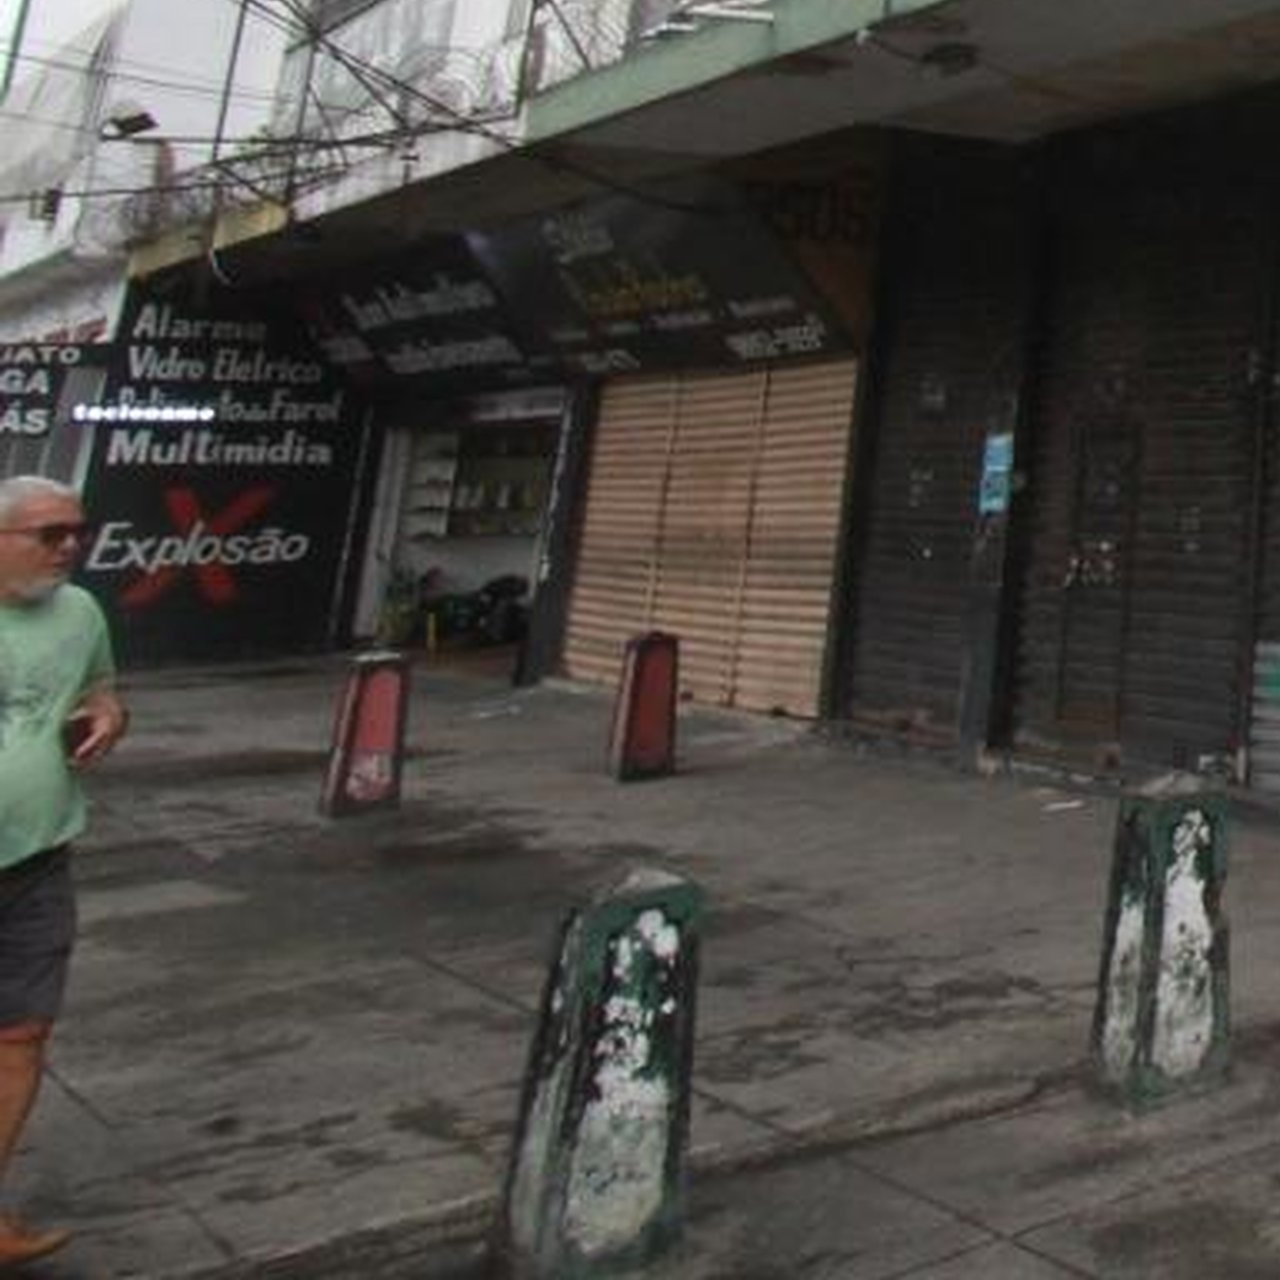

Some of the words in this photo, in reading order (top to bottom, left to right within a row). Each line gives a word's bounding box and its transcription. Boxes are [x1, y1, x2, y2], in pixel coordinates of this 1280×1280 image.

[129, 346, 205, 380] Vidro
[270, 389, 343, 420] Farol
[106, 428, 333, 465] Multimidia
[85, 518, 310, 574] Explosão
